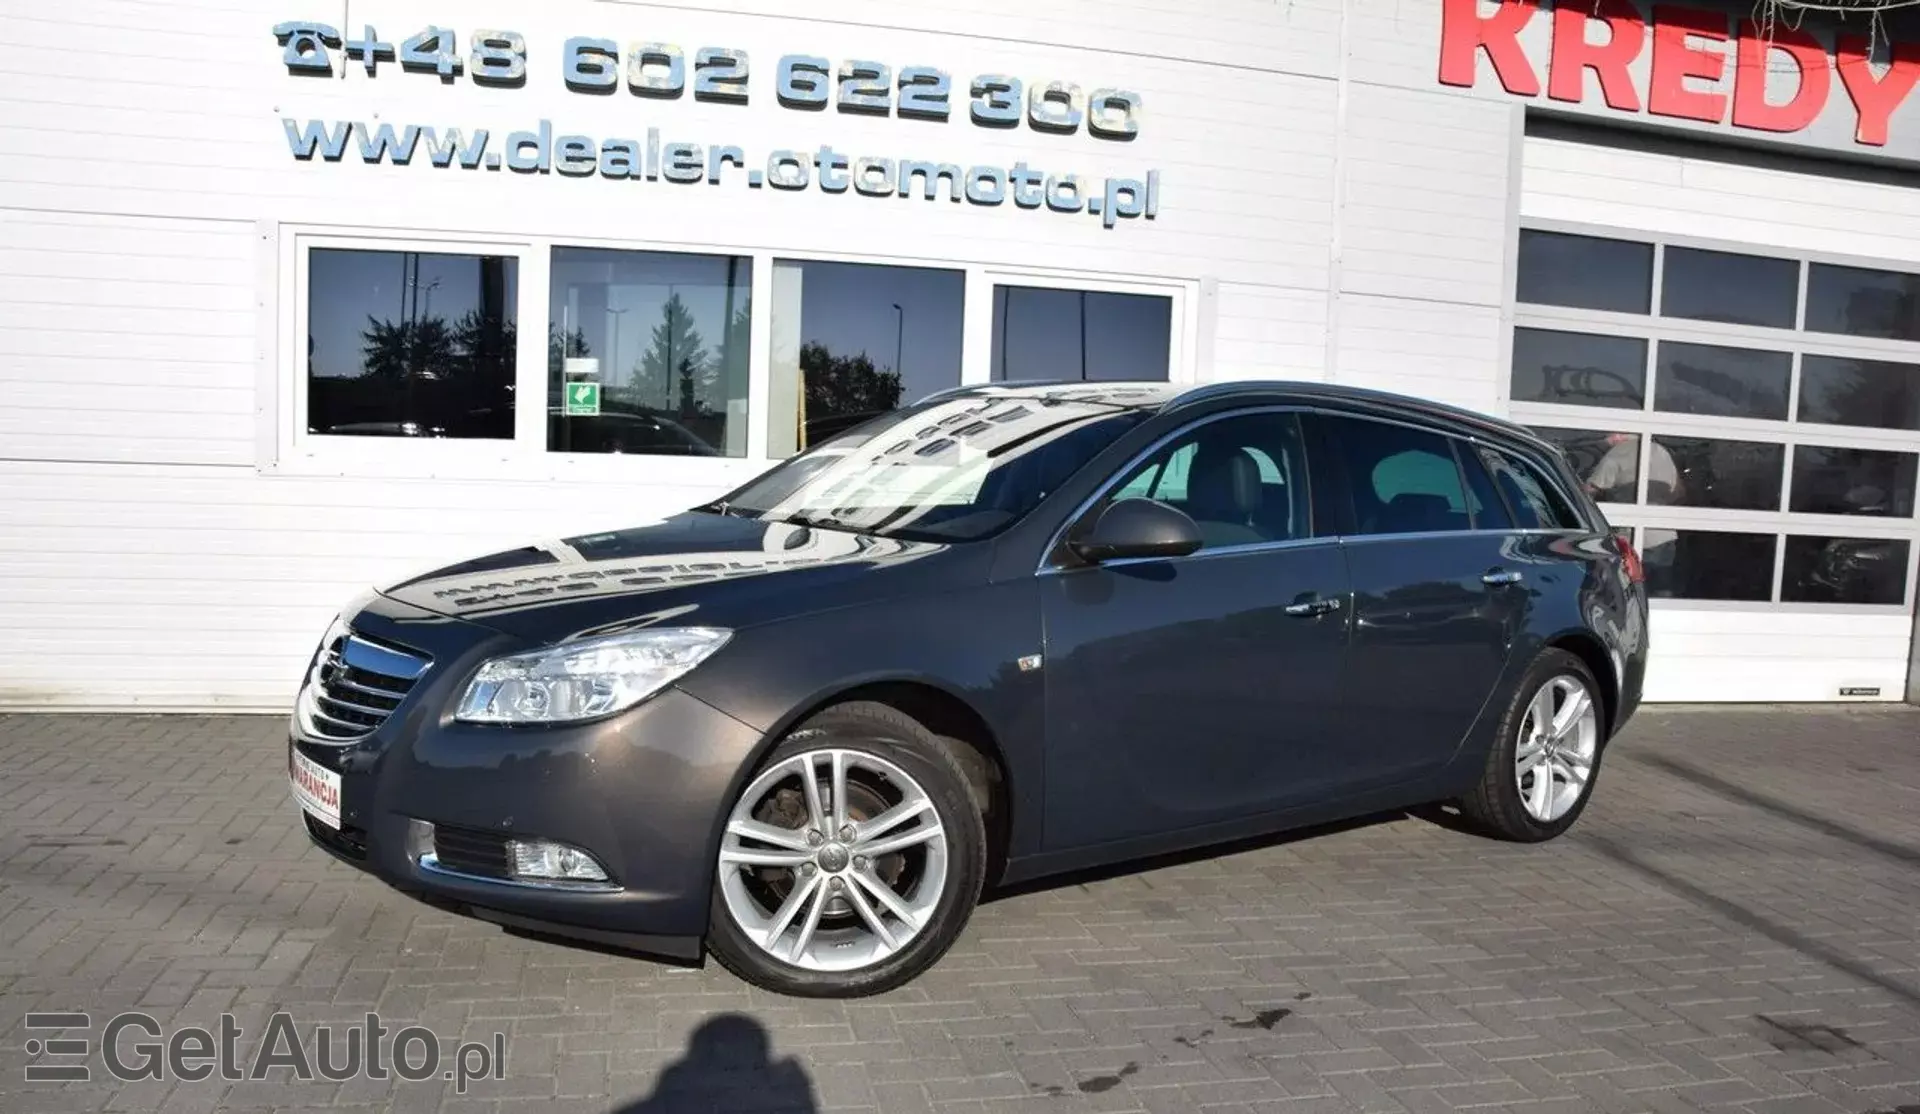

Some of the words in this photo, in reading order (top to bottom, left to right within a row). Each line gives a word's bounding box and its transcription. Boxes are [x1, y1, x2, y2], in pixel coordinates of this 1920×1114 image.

[346, 24, 527, 88] +48
[563, 36, 749, 105] 602
[776, 54, 950, 122] 622
[970, 74, 1143, 141] 300
[282, 118, 1161, 229] www.dealer.otomoto.pl
